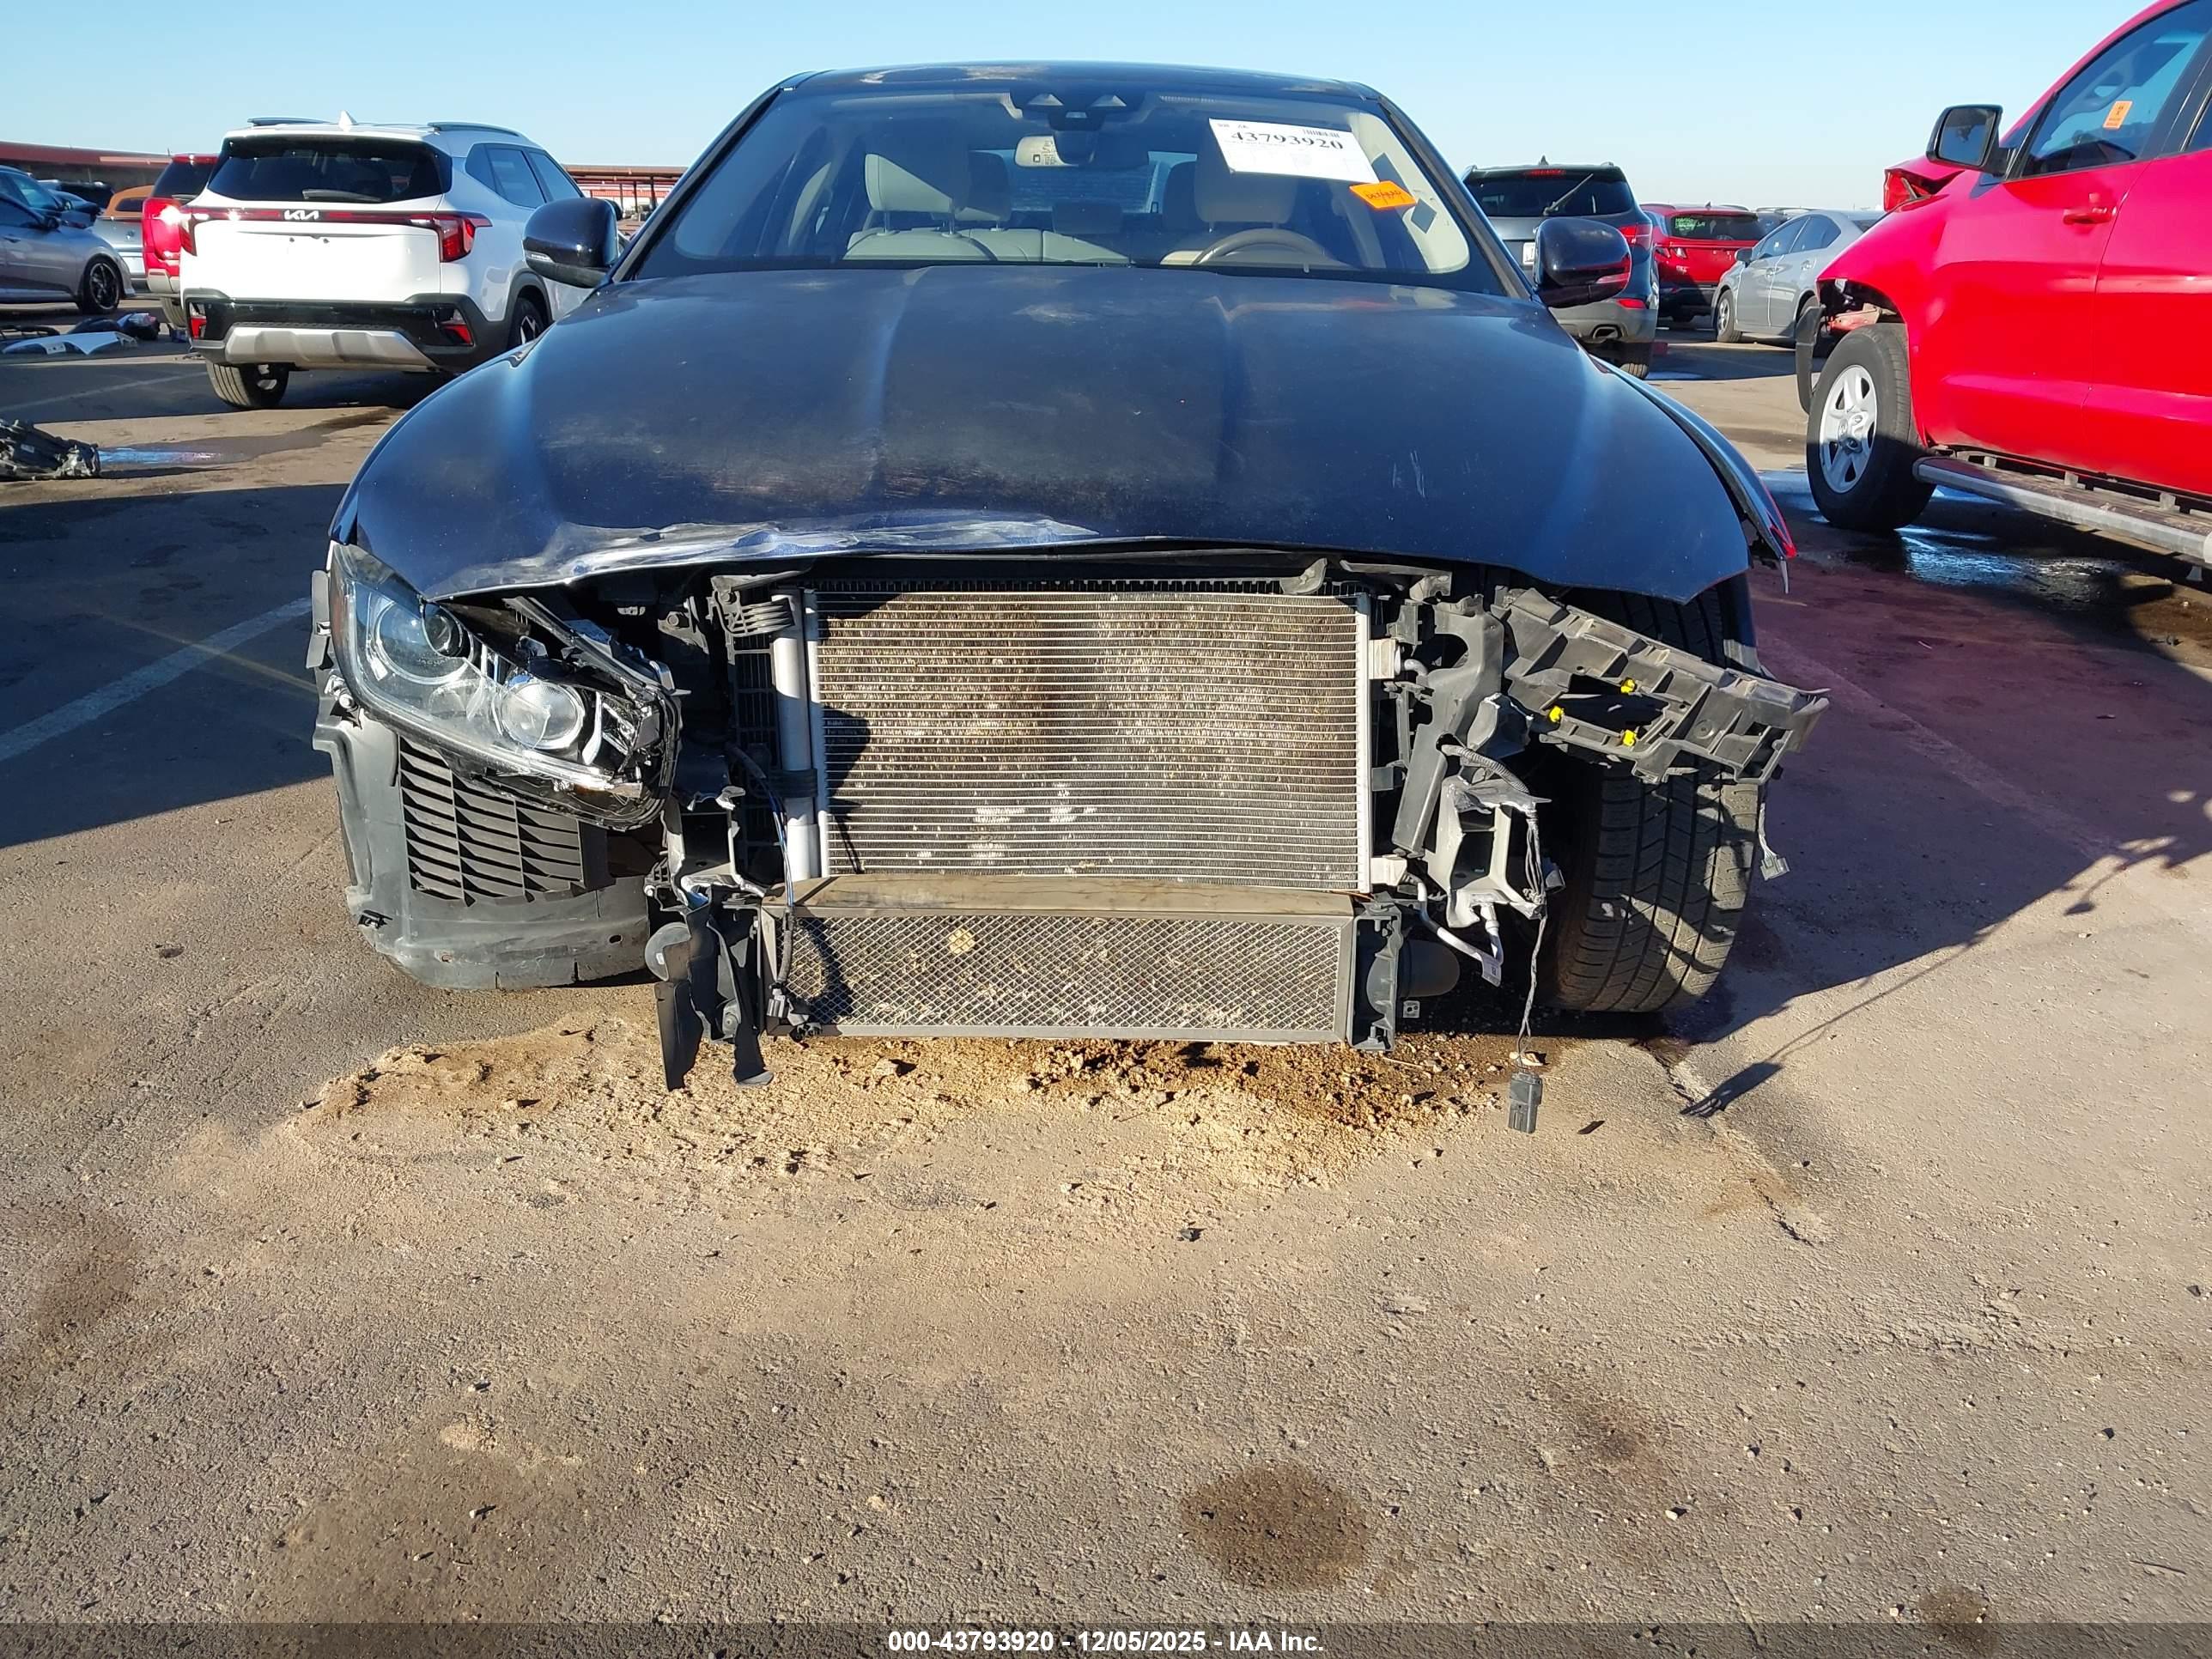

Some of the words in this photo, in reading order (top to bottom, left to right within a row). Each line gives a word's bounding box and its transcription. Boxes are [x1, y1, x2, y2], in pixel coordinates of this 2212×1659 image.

[1231, 131, 1344, 150] 43793920
[283, 209, 319, 221] KIA
[416, 659, 448, 667] JAGUA
